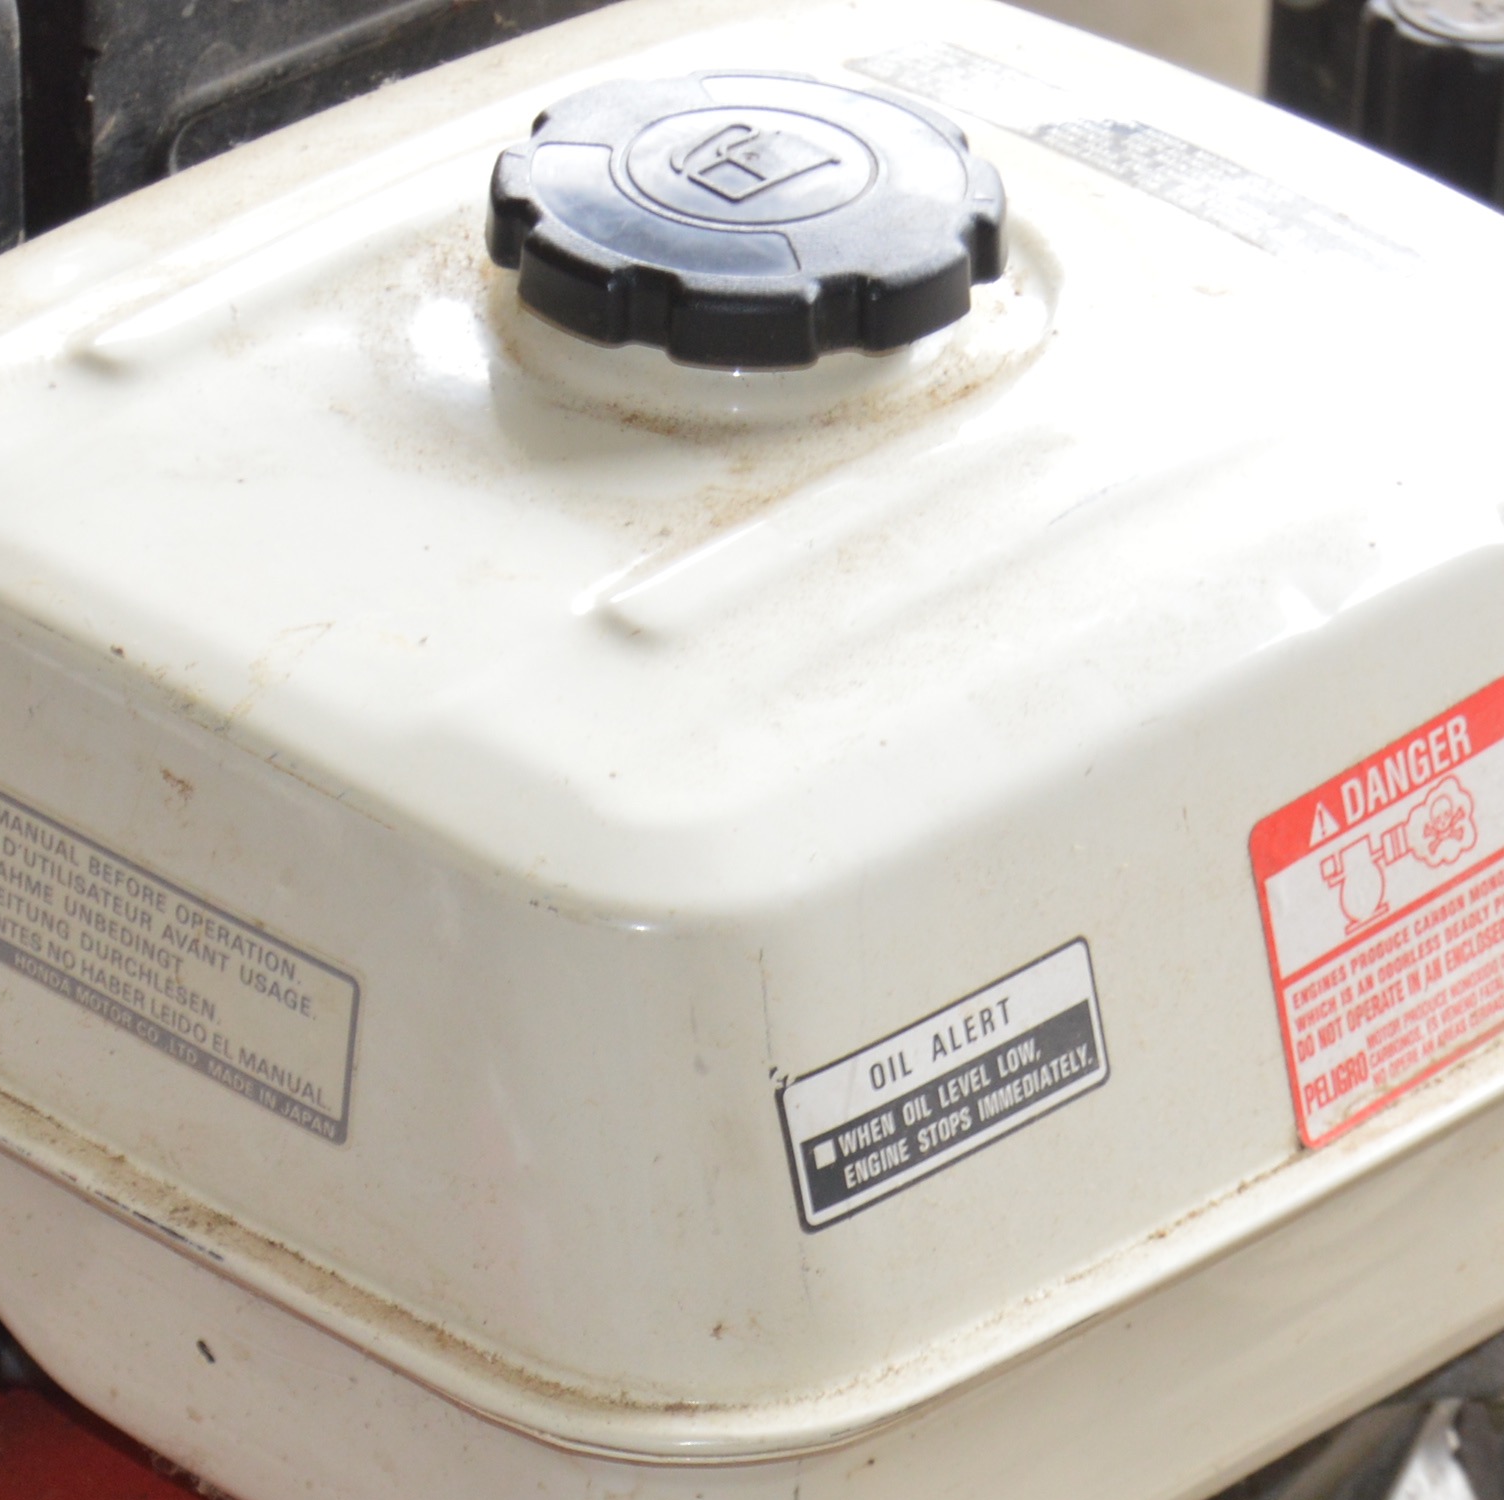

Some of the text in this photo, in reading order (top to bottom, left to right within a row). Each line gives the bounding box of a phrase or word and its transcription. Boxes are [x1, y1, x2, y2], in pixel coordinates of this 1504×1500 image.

[1340, 712, 1471, 826] DANGER
[2, 836, 152, 932] D'UTILISATEUR
[162, 922, 228, 974] AVANT
[239, 964, 316, 1021] USAGE.
[64, 895, 183, 976] UNBEDINGT
[80, 931, 221, 1025] DURCHLESEN.
[89, 856, 166, 913] BEFORE
[175, 902, 301, 986] OPERATION.
[1292, 964, 1346, 1010] ENGINES
[1350, 926, 1409, 975] PRODUCE
[1414, 893, 1464, 937] CARBON
[1294, 995, 1336, 1033] WHICH
[1340, 986, 1352, 1005] IS
[1357, 973, 1373, 995] AN
[1444, 903, 1489, 943] DEADLY
[15, 952, 69, 996] HONDA
[76, 986, 130, 1030] MOTOR
[208, 1059, 252, 1097] MADE
[259, 1087, 276, 1110] IN
[281, 1097, 334, 1141] JAPAN
[47, 940, 75, 972] NO
[80, 959, 144, 1010] HABER
[150, 997, 206, 1045] LEIDO
[212, 1031, 233, 1060] EL
[869, 998, 1011, 1090] OIL ALERT
[1296, 1034, 1315, 1062] DO
[1317, 1017, 1342, 1050] NOT
[1346, 980, 1404, 1032] OPERATE
[1407, 970, 1420, 995] IN
[1425, 957, 1442, 985] AN
[839, 1037, 1040, 1157] WHEN OIL LEVEL LOW,
[845, 1043, 1091, 1188] ENGINE STOPS IMMEDIATELY.
[1304, 1049, 1369, 1115] PELIGRO
